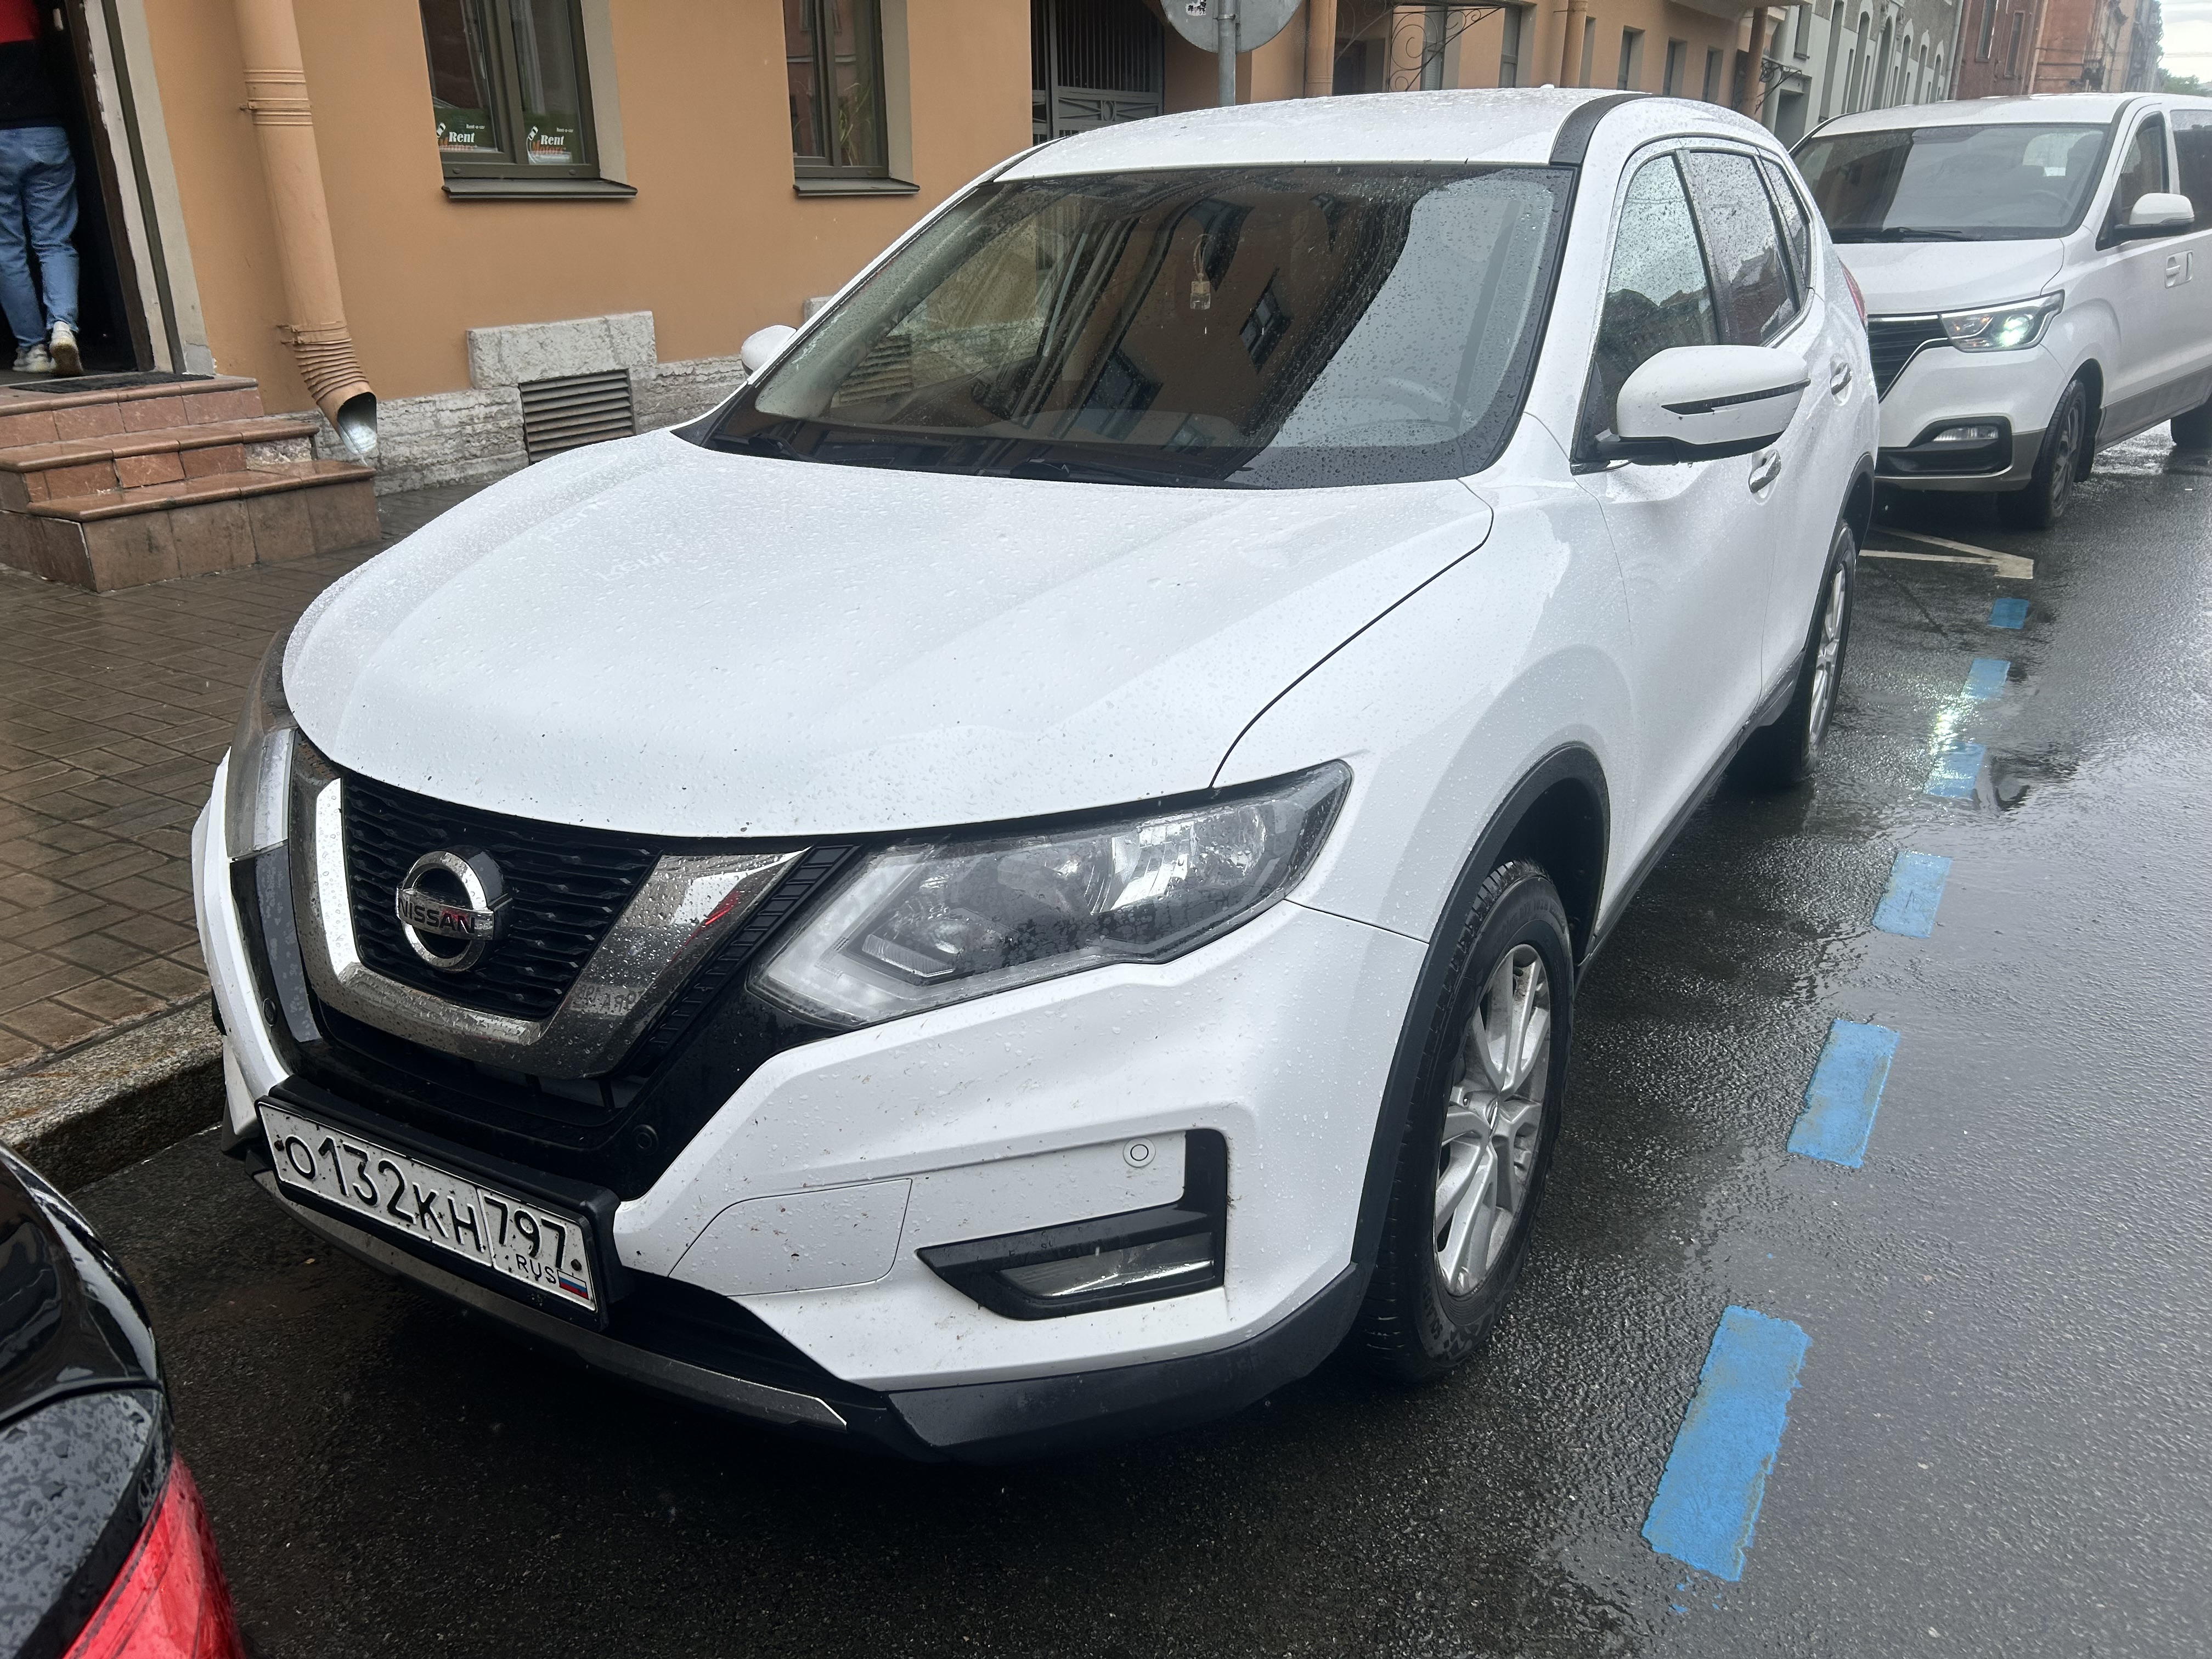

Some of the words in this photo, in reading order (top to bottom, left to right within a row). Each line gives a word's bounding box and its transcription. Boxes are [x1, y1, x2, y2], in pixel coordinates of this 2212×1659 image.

[448, 132, 475, 143] Rent
[540, 135, 565, 145] Rent
[398, 898, 475, 934] NISSAN
[284, 1135, 486, 1253] О132КН
[484, 1195, 567, 1269] 797
[516, 1254, 557, 1285] RUS
